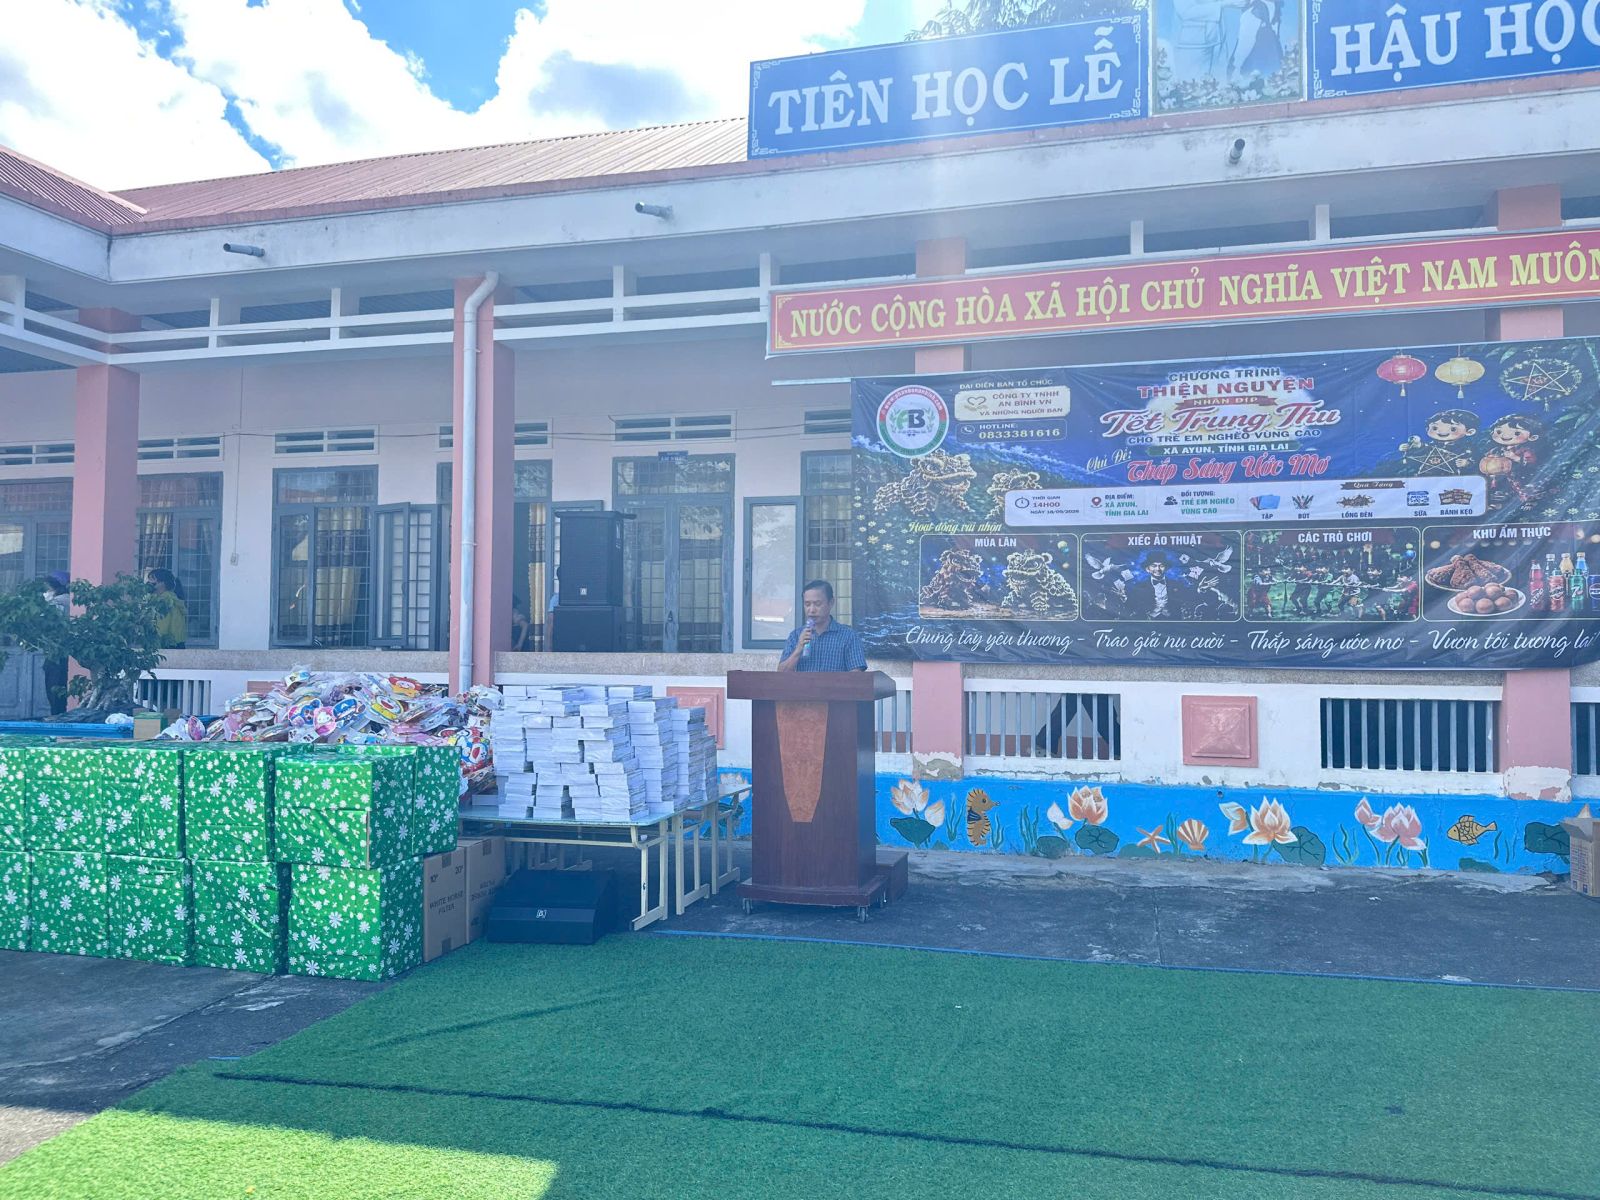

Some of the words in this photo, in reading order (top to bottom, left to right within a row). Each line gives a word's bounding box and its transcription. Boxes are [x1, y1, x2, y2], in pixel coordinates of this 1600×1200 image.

[1330, 3, 1463, 82] HẬU
[768, 70, 893, 135] TIÊN
[912, 62, 1029, 126] HỌC
[1049, 26, 1123, 106] LỄ
[790, 299, 861, 338] NƯỚC
[871, 294, 946, 337] CỘNG
[956, 287, 1016, 326] HÒA
[1024, 281, 1066, 320] XÃ
[1076, 276, 1130, 322] HỘI
[1140, 267, 1205, 312] CHỦ
[1219, 264, 1322, 306] NGHĨA
[1330, 256, 1410, 303] VIỆT
[1422, 256, 1498, 293] NAM
[1169, 370, 1230, 382] CHƯƠNG
[993, 392, 1017, 400] CÔNG
[1021, 391, 1031, 399] TY
[1137, 382, 1208, 399] THIỆN
[1217, 376, 1314, 395] NGUYỆN
[1101, 408, 1164, 437] Tết
[1171, 406, 1271, 434] Trung
[1276, 400, 1341, 429] Thu
[978, 428, 1060, 440] 0833381616
[1128, 436, 1152, 445] CHO
[1184, 434, 1203, 443] EM
[1255, 427, 1290, 439] VÙNG
[1295, 429, 1321, 438] CAO
[1248, 444, 1269, 452] GIA
[1271, 443, 1289, 451] LAI
[1127, 457, 1178, 485] Thắp
[1182, 457, 1236, 483] Sáng
[1241, 452, 1283, 478] Ước
[1288, 453, 1331, 477] Mơ
[1128, 534, 1152, 546] XIẾC
[1153, 532, 1168, 546] ẢO
[1170, 534, 1203, 546] THUẬT
[1298, 531, 1323, 543] CÁC
[1324, 530, 1343, 542] TRÒ
[1345, 530, 1373, 542] CHƠI
[1473, 528, 1497, 539] KHU
[1499, 525, 1517, 538] ẨM
[1520, 526, 1552, 538] THỰC
[975, 536, 996, 547] MÚA
[999, 535, 1017, 547] LÂN
[904, 625, 957, 652] Chung
[958, 631, 984, 651] tay
[985, 632, 1013, 652] yêu
[1015, 630, 1074, 655] thương
[1093, 629, 1129, 649] Trao
[1132, 630, 1161, 656] gửi
[1164, 637, 1188, 652] nụ
[1190, 632, 1225, 650] cười
[1247, 630, 1292, 654] Thắp
[1294, 634, 1337, 658] sáng
[1340, 633, 1372, 650] ước
[1374, 637, 1404, 651] mơ
[1428, 628, 1479, 650] Vươn
[1484, 631, 1510, 650] tới
[1512, 634, 1571, 658] tương
